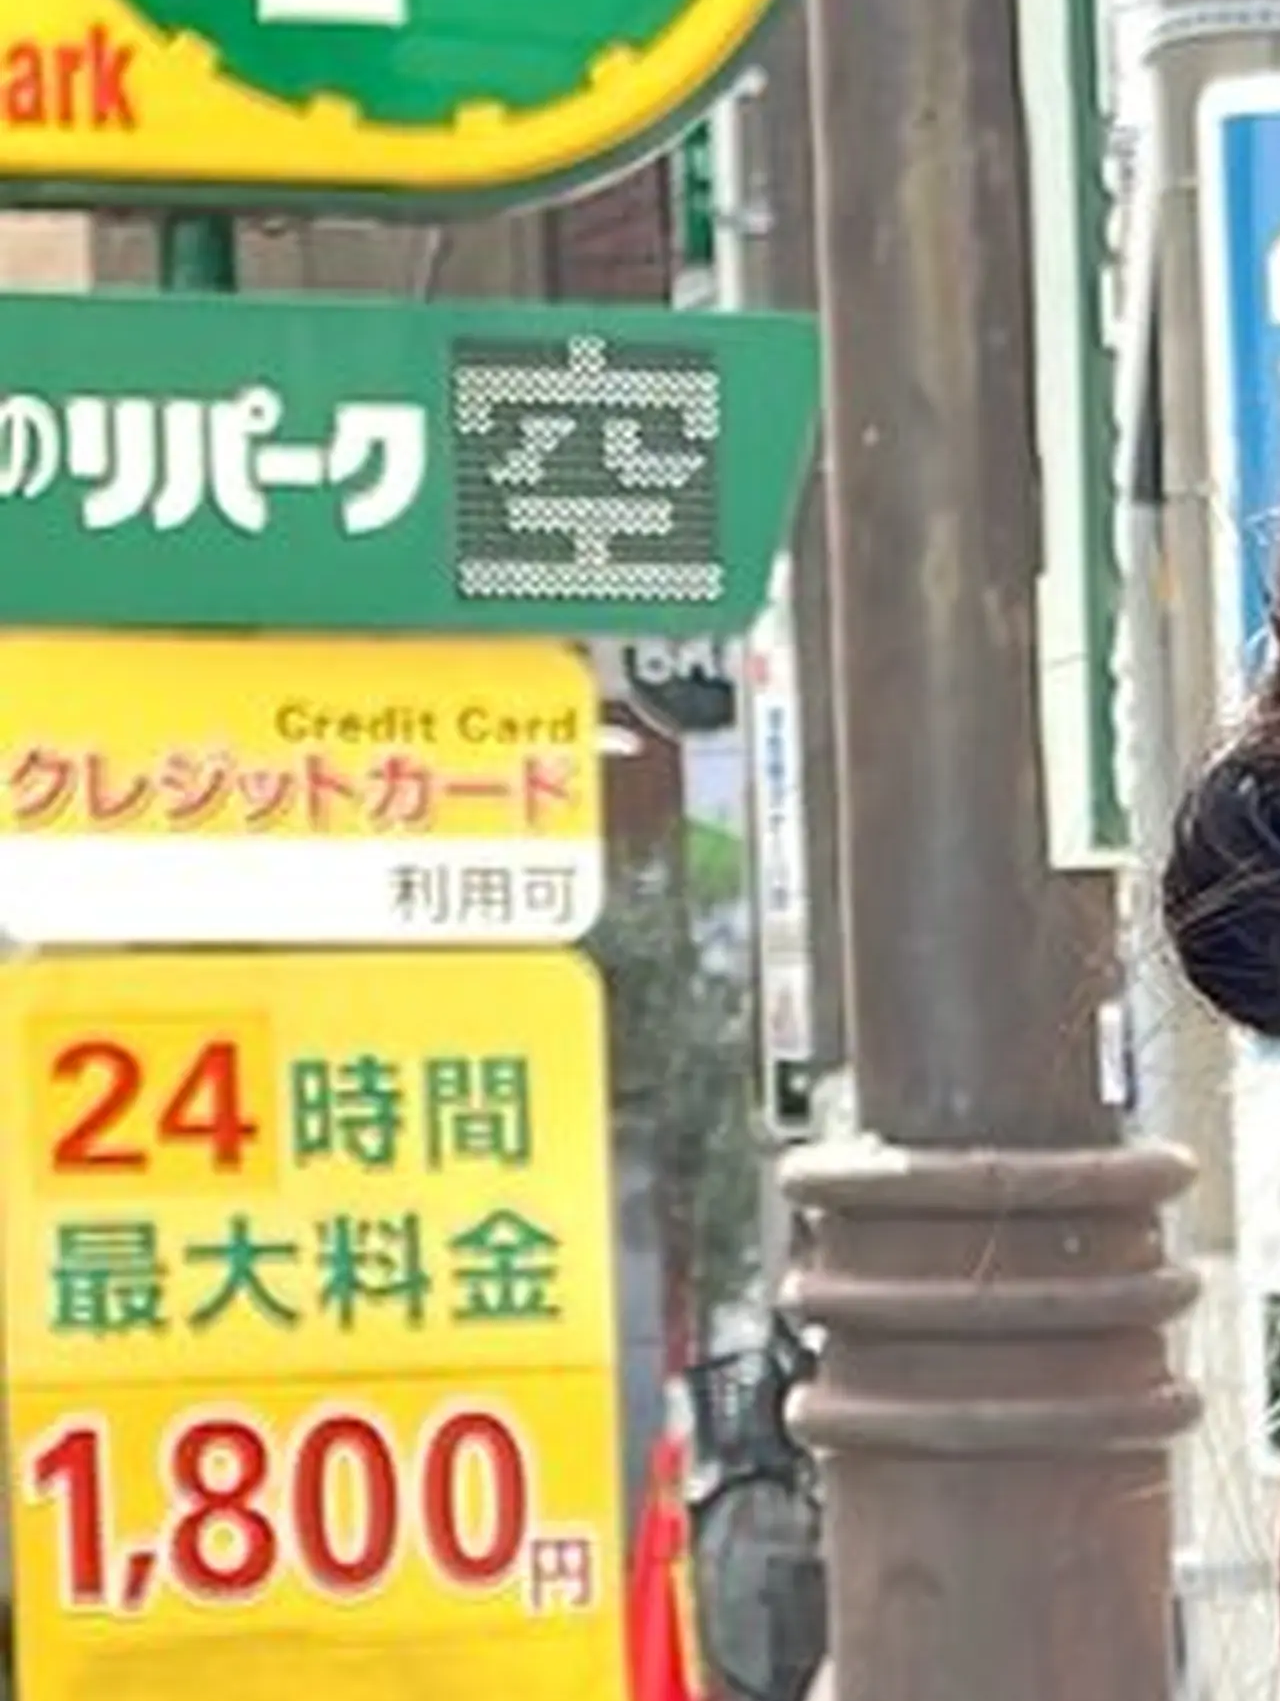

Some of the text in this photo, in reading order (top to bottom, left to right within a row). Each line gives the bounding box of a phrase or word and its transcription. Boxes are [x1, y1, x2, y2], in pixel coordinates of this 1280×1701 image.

[7, 25, 135, 129] ark
[0, 385, 427, 531] のリパーク
[455, 335, 722, 600] 空
[276, 704, 579, 746] Credit Card
[10, 747, 572, 829] クレジットカード
[391, 862, 576, 923] 利用可
[48, 1208, 562, 1336] 最大料金
